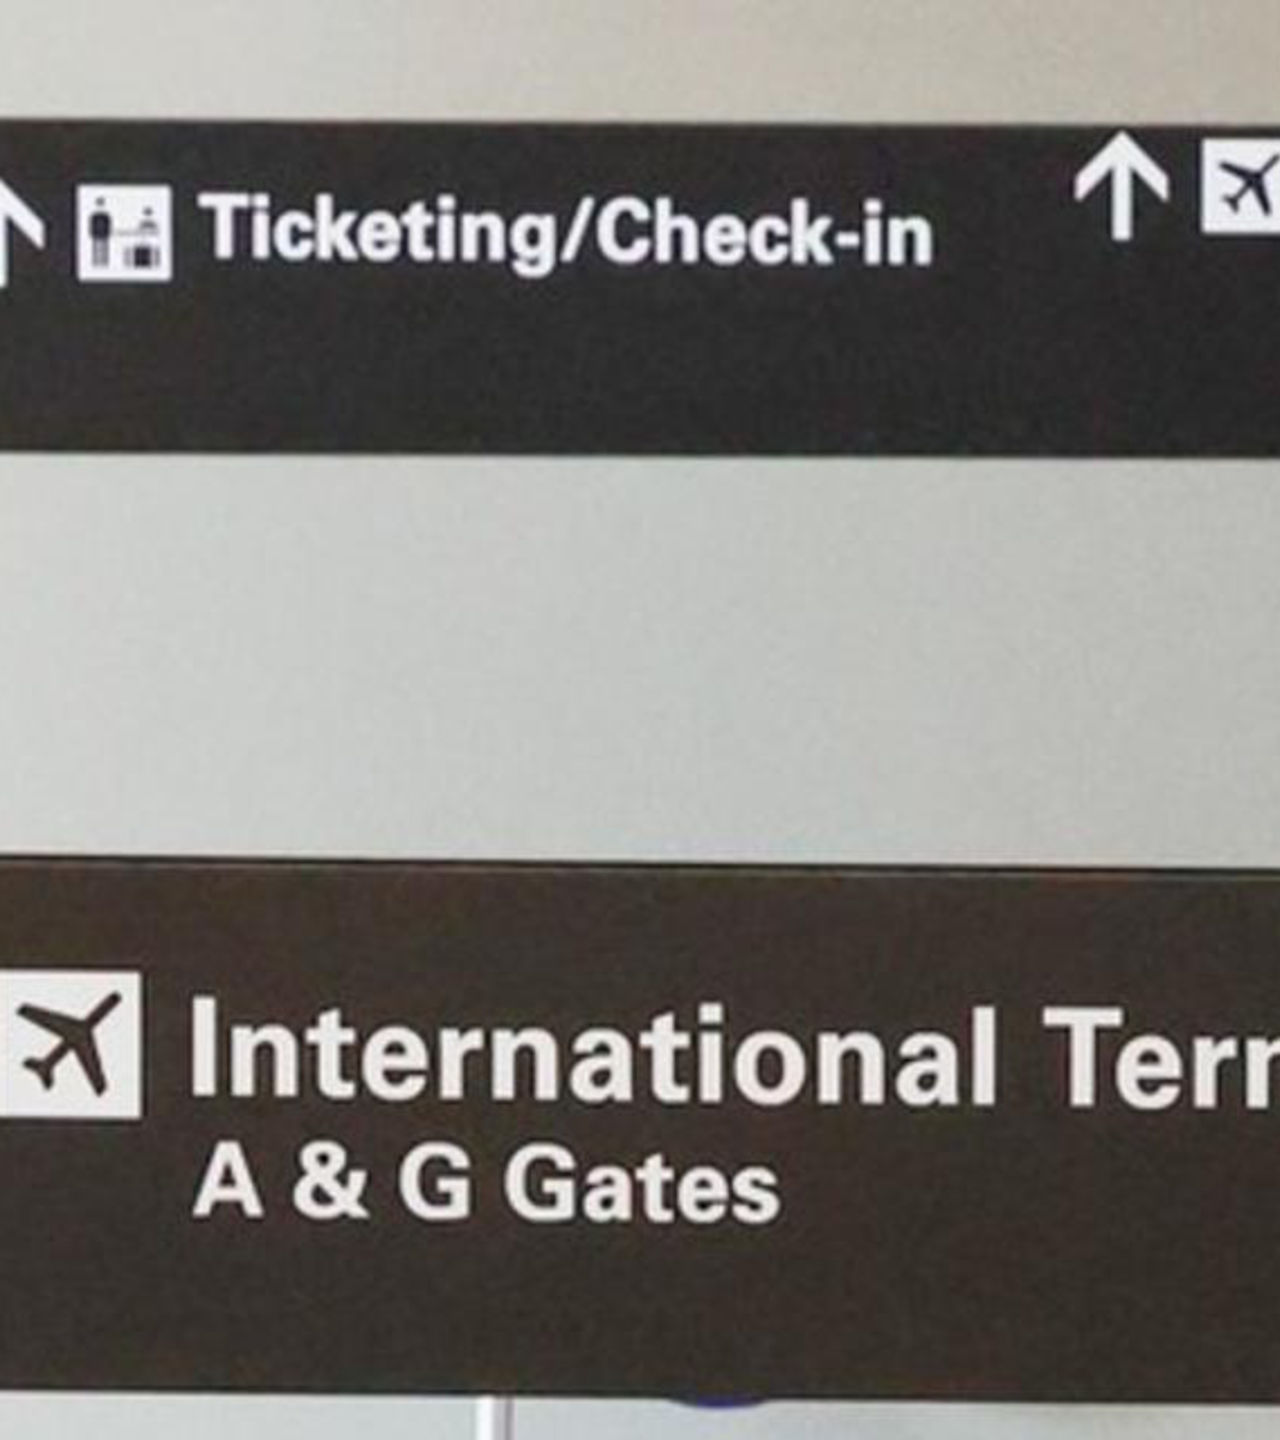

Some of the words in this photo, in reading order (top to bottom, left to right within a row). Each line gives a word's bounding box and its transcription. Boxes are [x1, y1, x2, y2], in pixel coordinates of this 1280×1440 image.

[197, 192, 932, 279] Ticketing/Check-in
[192, 995, 996, 1106] International
[193, 1140, 263, 1217] A
[293, 1140, 369, 1219] &
[399, 1141, 470, 1220] G
[505, 1143, 780, 1224] Gates
